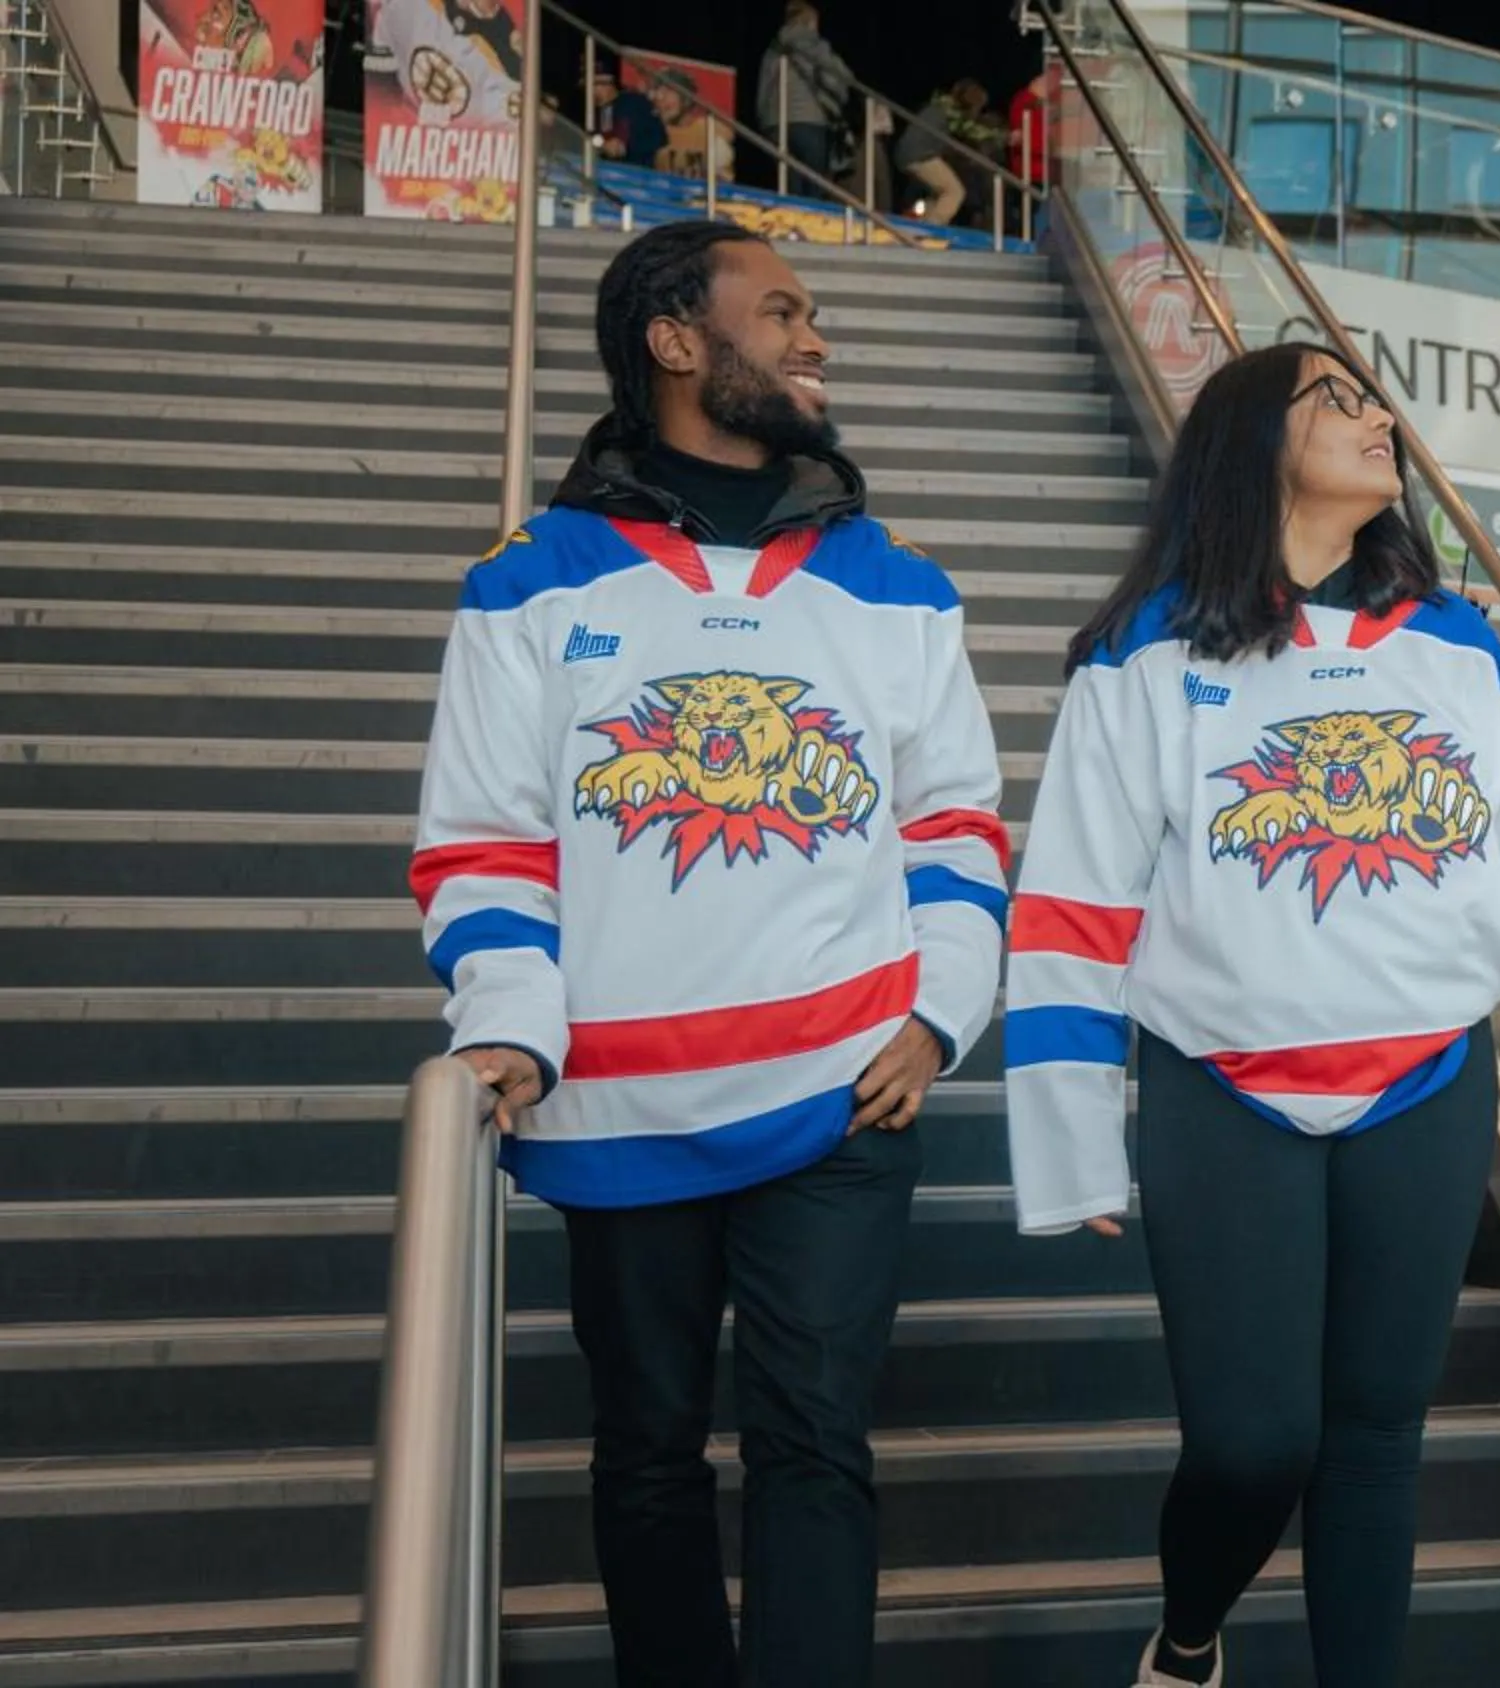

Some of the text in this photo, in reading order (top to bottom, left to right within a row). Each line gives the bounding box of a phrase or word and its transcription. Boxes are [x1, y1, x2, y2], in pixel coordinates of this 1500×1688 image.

[152, 66, 314, 136] CRAWFORD
[376, 123, 520, 182] MARCHAN
[701, 617, 760, 630] CCM
[1310, 667, 1365, 679] CCM
